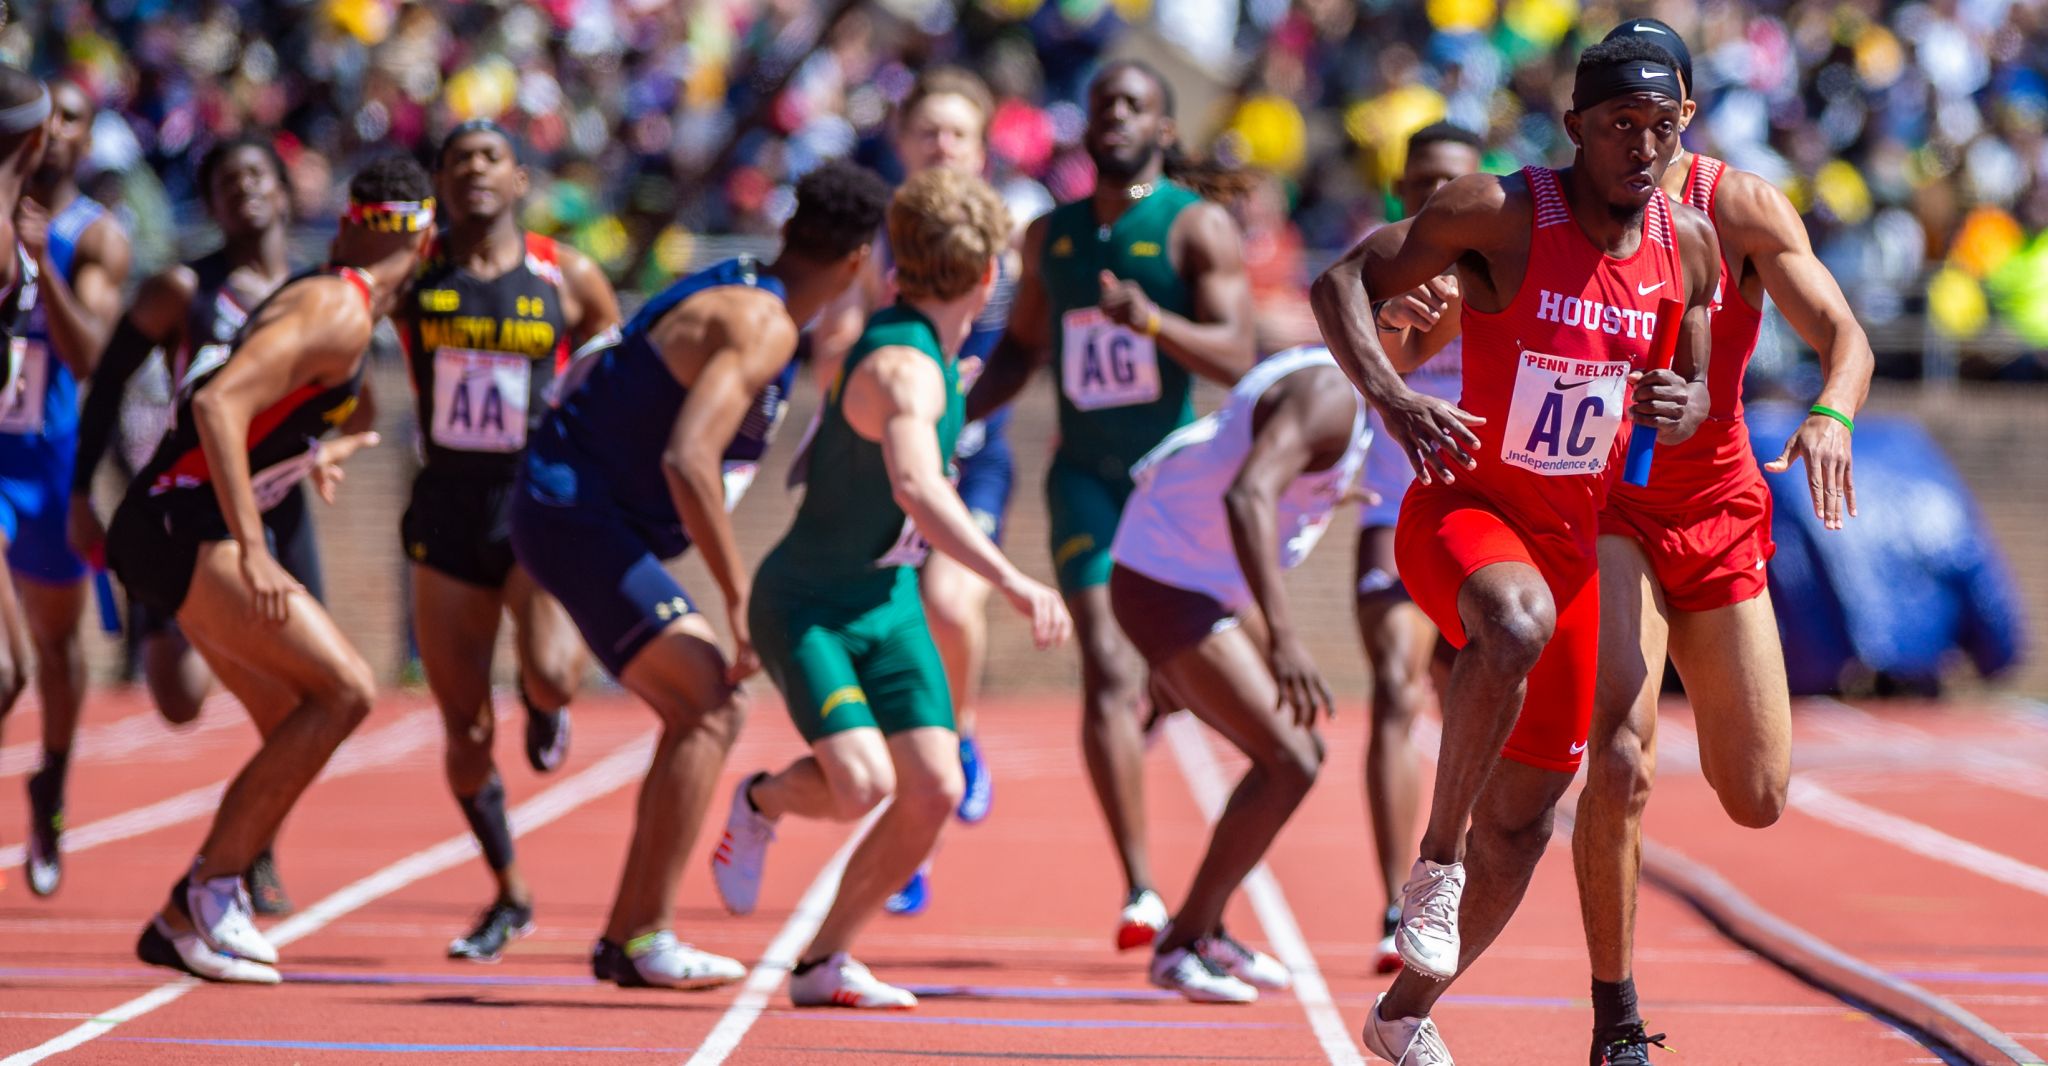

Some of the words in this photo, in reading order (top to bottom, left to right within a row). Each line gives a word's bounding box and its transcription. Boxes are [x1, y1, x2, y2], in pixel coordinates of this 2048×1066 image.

[1537, 289, 1656, 340] HOUSTO
[1081, 335, 1135, 387] AG
[1527, 354, 1569, 374] PENN
[1574, 363, 1625, 377] RELAYS
[449, 382, 505, 431] AA
[1525, 391, 1605, 457] AC
[1508, 450, 1586, 470] Independence
